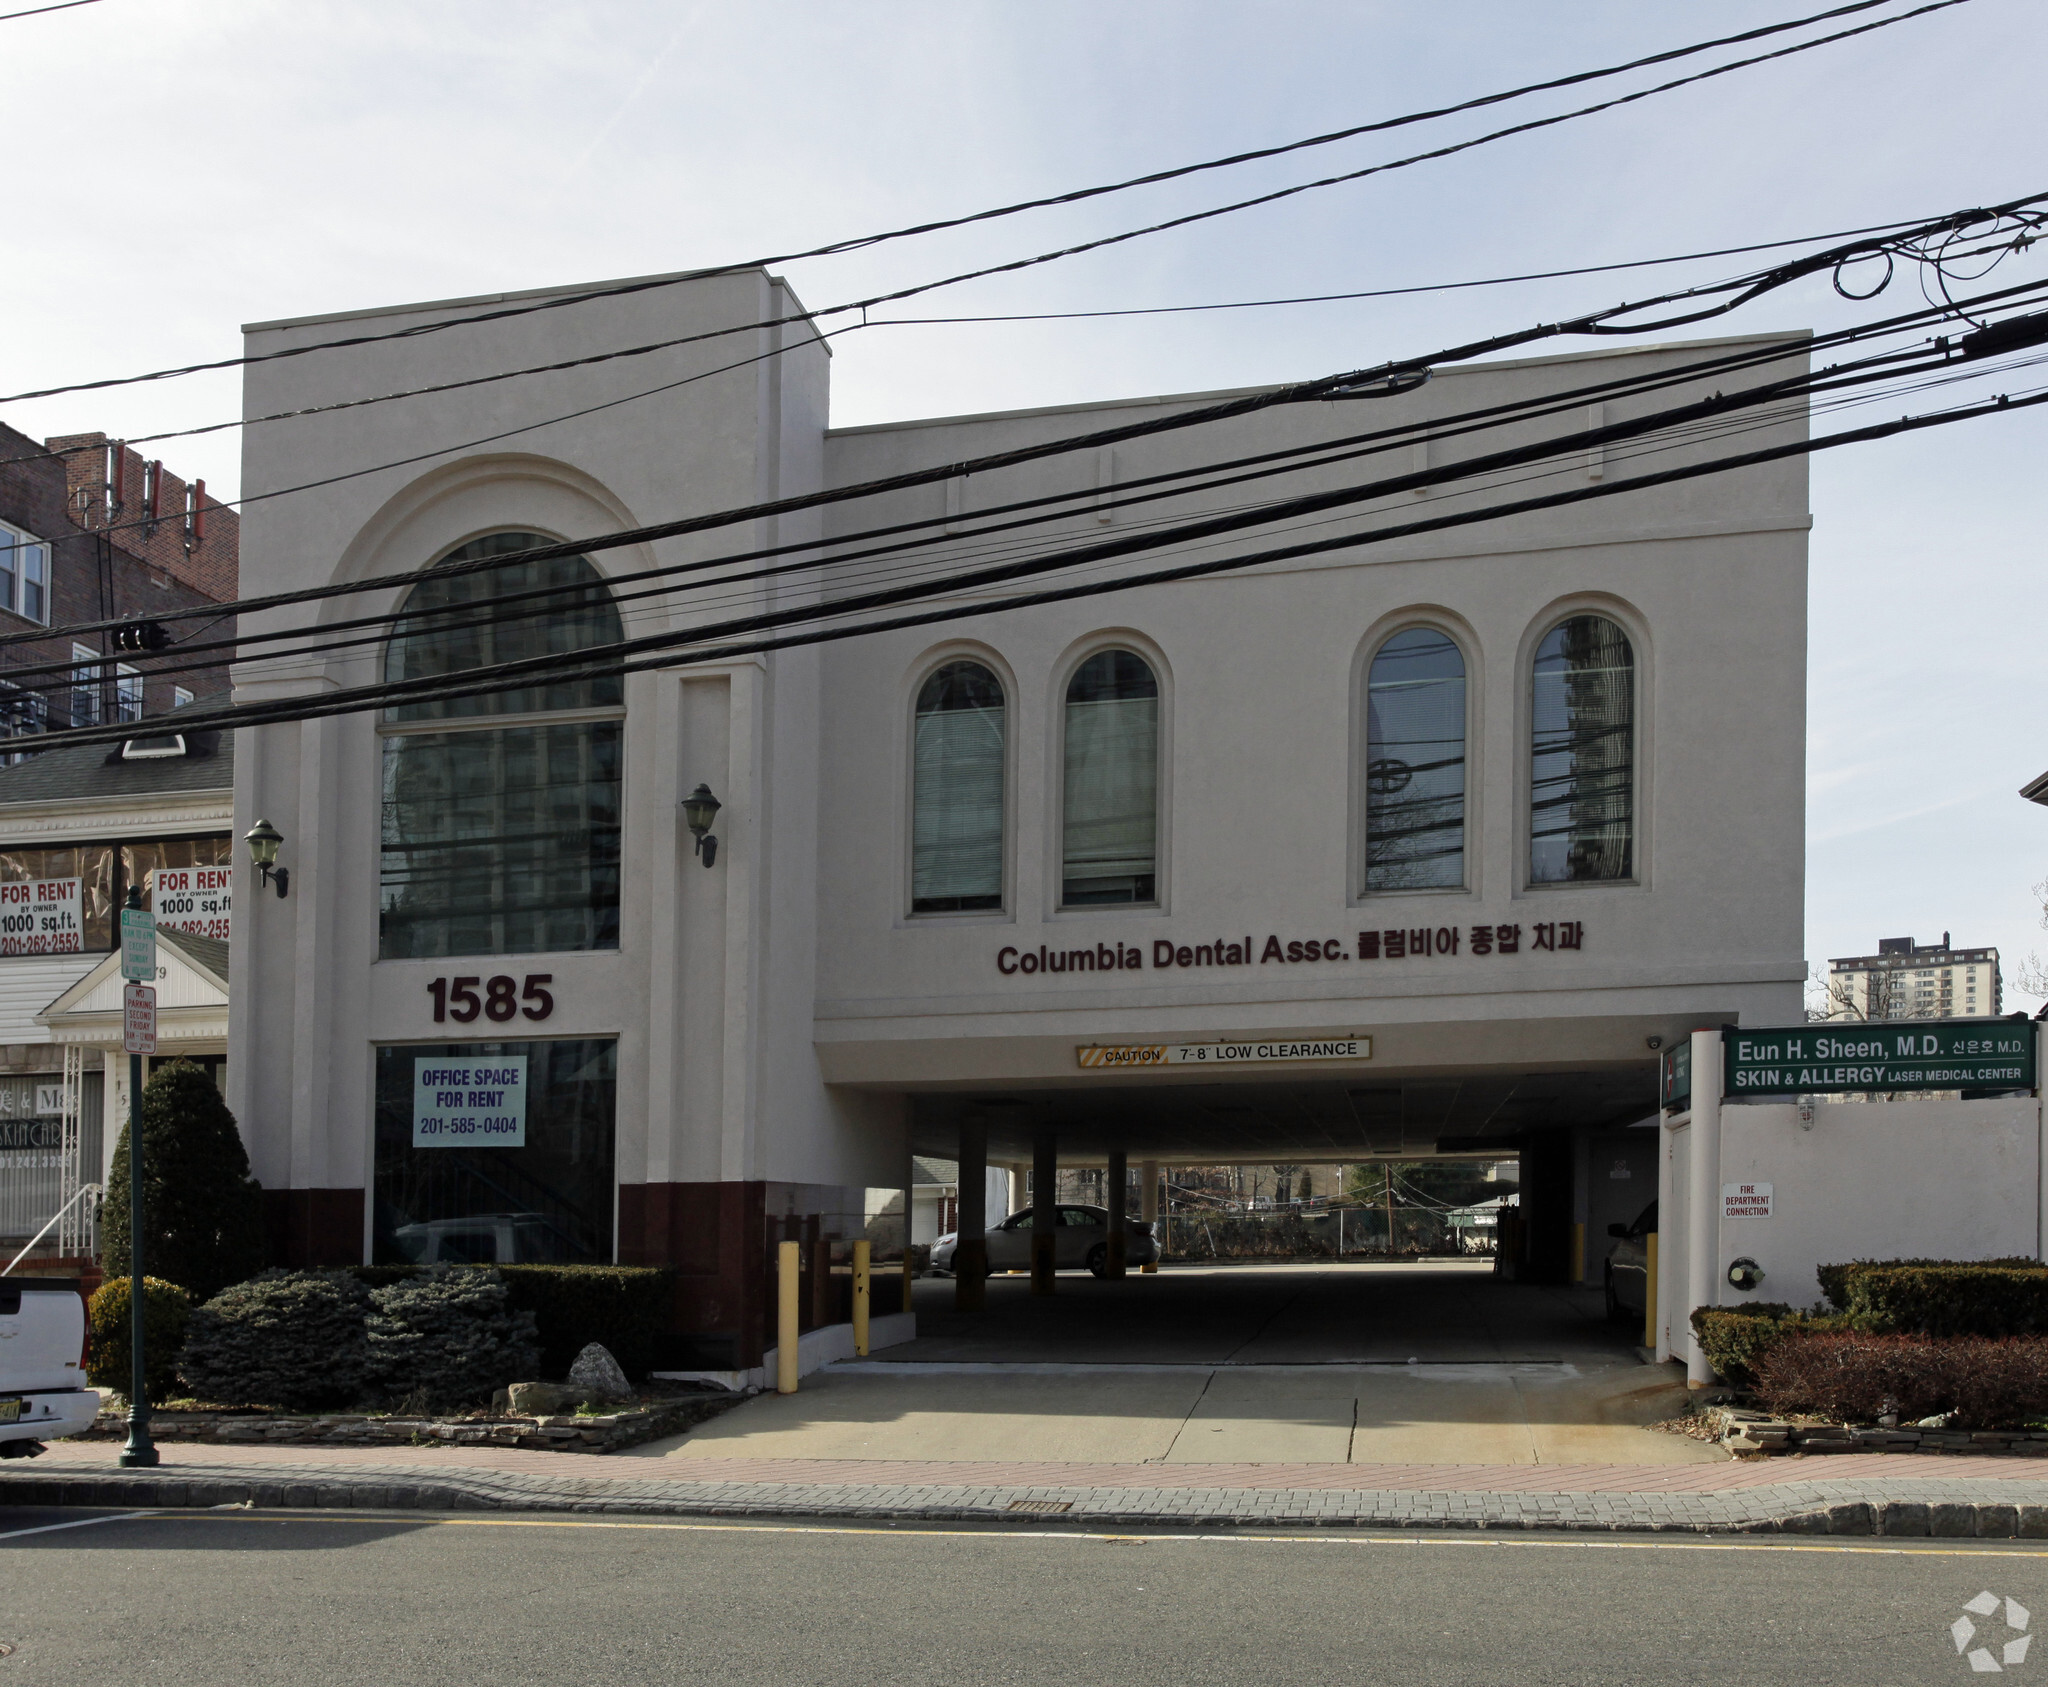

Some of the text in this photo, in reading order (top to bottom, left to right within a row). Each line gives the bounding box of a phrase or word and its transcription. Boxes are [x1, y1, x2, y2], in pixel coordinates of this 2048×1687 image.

[159, 873, 188, 891] FOR
[1, 881, 76, 904] FOR RENT
[21, 904, 58, 913] BY OWNER
[160, 898, 194, 914] 1000
[1, 911, 76, 932] 1000 sq.ft.
[1, 932, 80, 954] 201-262-2552
[998, 942, 1142, 974] Columbia
[1153, 937, 1251, 968] Dental
[1260, 935, 1349, 964] Assc.
[1470, 924, 1522, 955] 종합
[1531, 921, 1584, 951] 치과
[135, 989, 145, 998] NO
[427, 974, 554, 1023] 1585
[127, 999, 153, 1010] PARKING
[129, 1010, 152, 1021] SECOND
[129, 1020, 151, 1030] FRIDAY
[1105, 1050, 1160, 1062] CAUTION
[1216, 1046, 1252, 1059] LOW
[1257, 1042, 1357, 1058] CLEARANCE
[1738, 1035, 2025, 1061] Eun H. Sheen, M.D. 신은호 M.D.
[422, 1068, 519, 1086] OFFICE SPACE
[1735, 1067, 2021, 1087] SKIN & ALLERGY LASER MEDICAL CENTER
[436, 1091, 504, 1108] FOR RENT
[420, 1117, 517, 1134] 201-585-0404
[1740, 1185, 1755, 1194] FIRE
[1725, 1196, 1769, 1205] DEPARTMENT
[1726, 1207, 1769, 1216] CONNECTION
